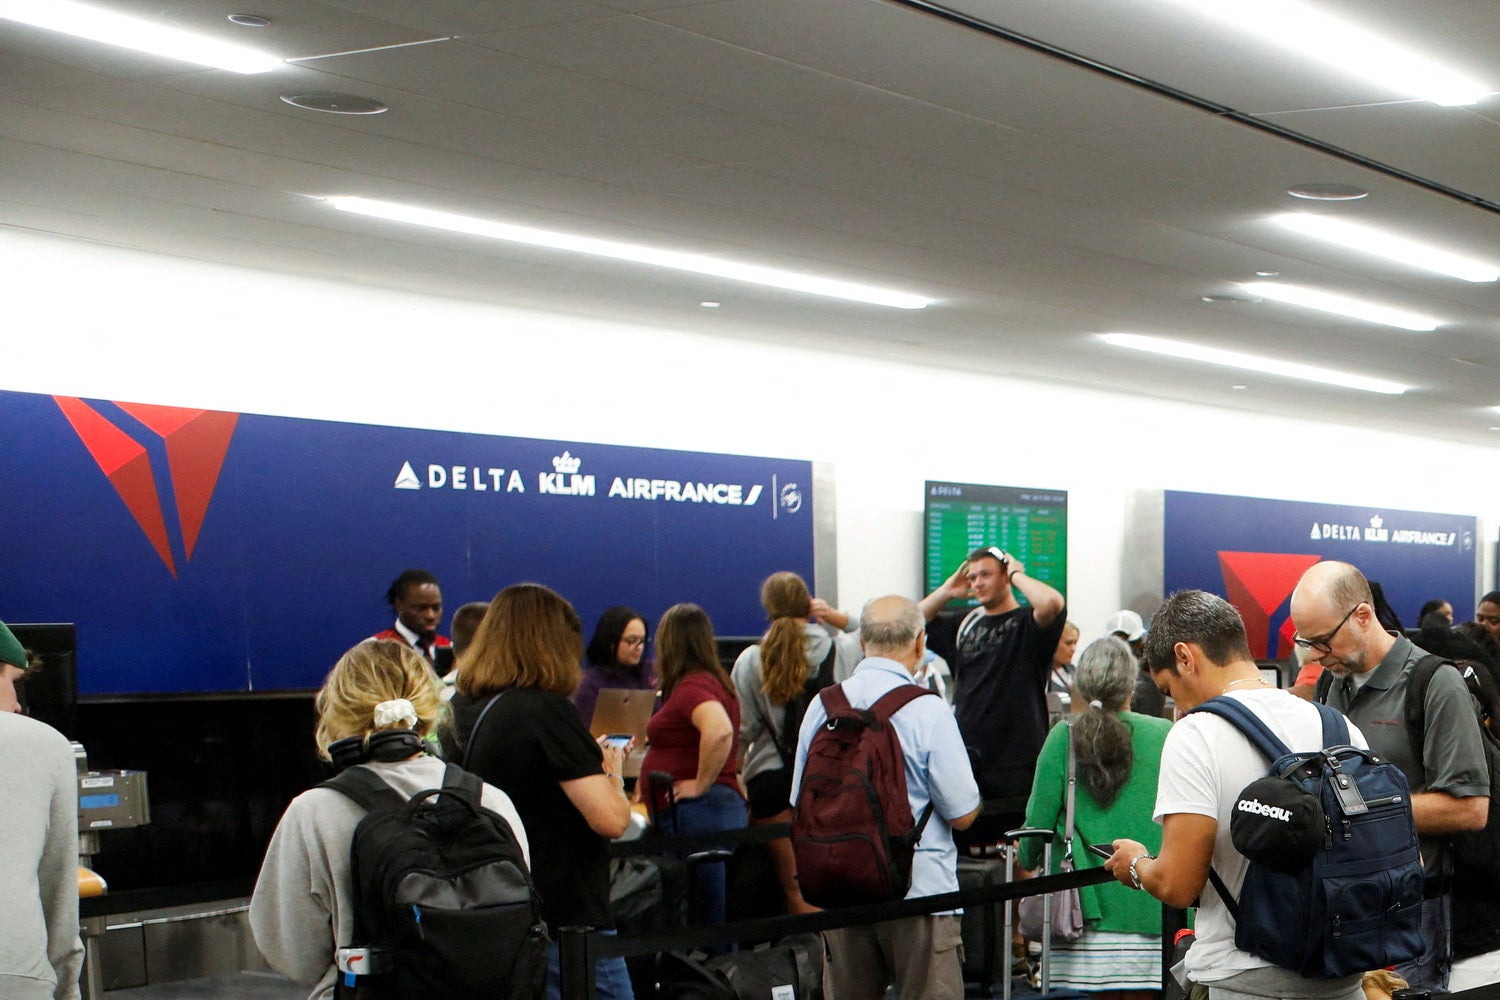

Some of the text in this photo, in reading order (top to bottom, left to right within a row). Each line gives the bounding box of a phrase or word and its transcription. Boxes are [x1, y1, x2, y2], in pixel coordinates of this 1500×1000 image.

[428, 464, 525, 494] DELTA
[538, 472, 596, 497] KLM
[1322, 523, 1361, 541] DELTA
[1238, 799, 1291, 822] cabeau
